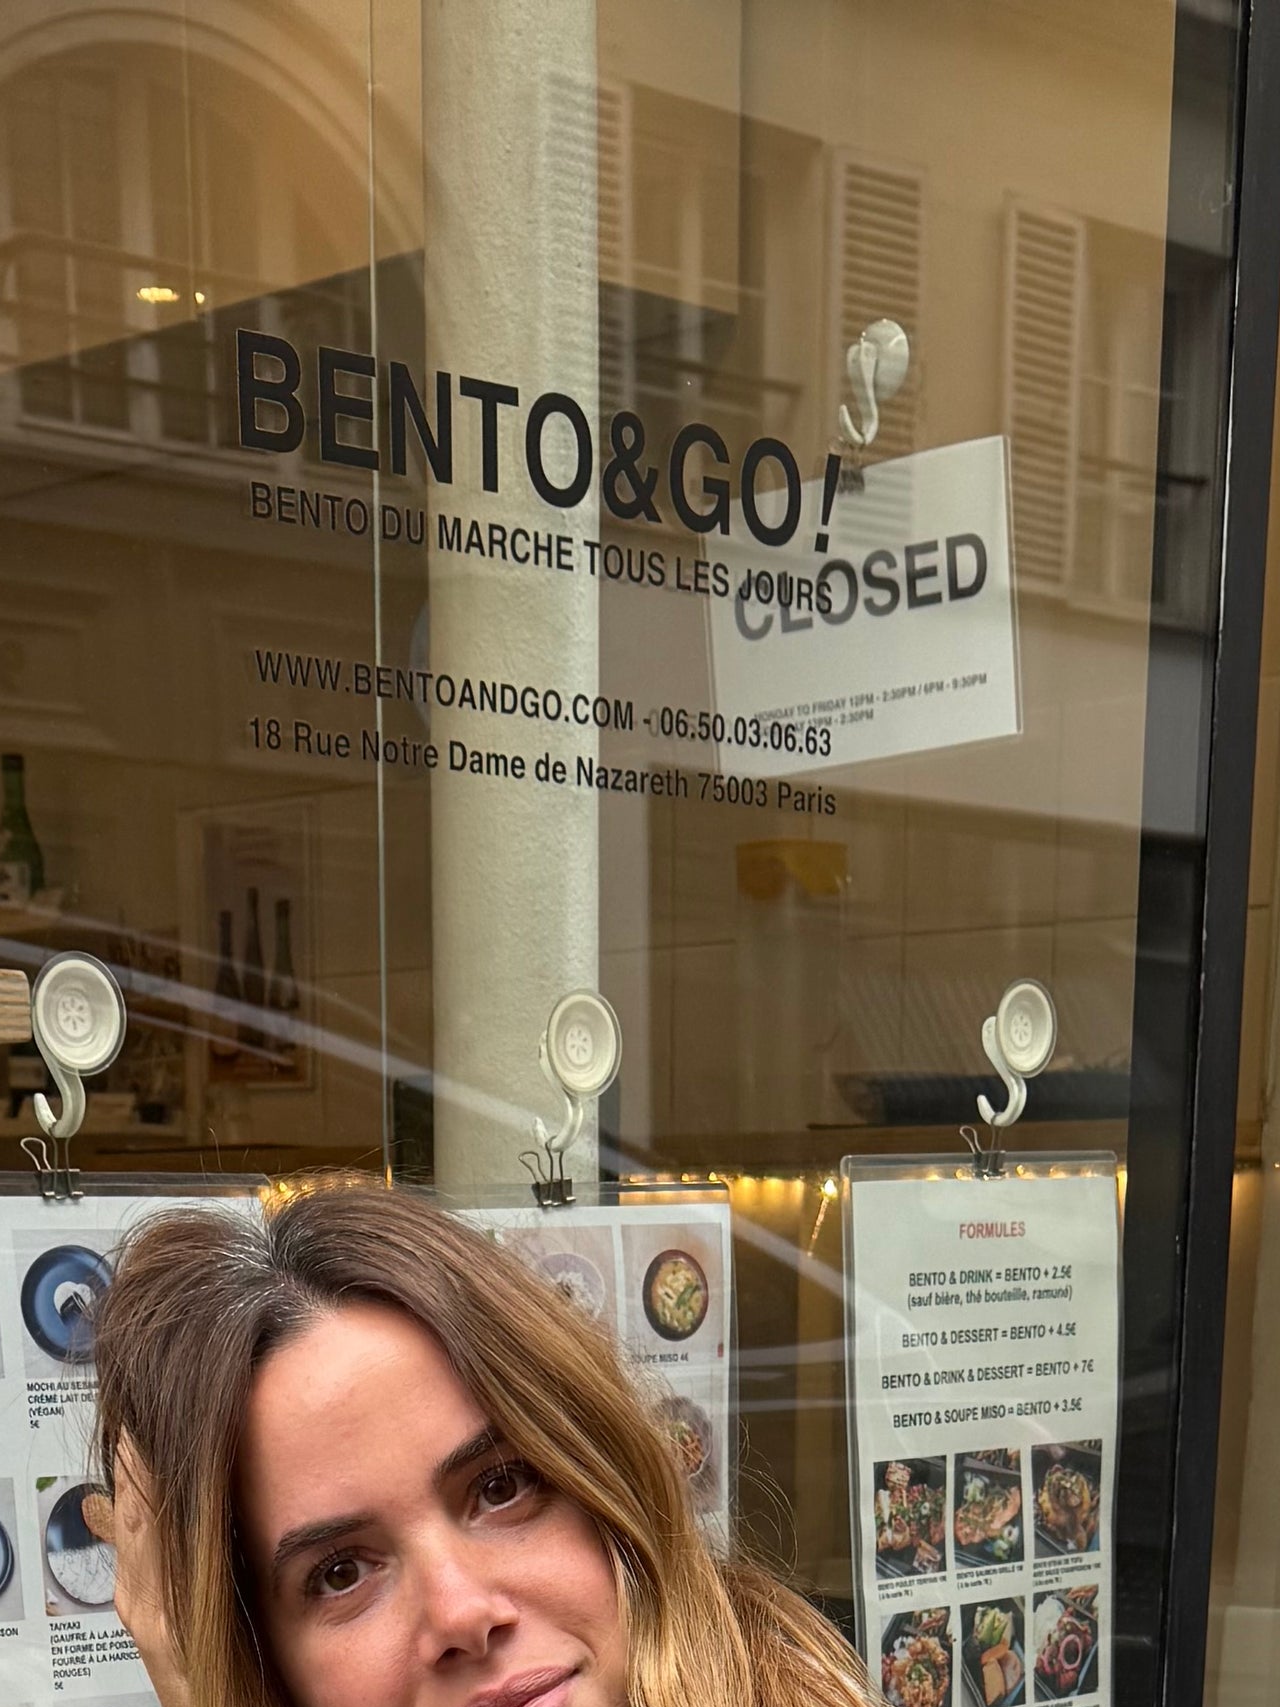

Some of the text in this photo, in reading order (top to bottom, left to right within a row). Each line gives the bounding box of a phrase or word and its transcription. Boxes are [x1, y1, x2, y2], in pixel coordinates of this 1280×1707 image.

[235, 328, 841, 554] BENTO&GO!
[250, 481, 833, 615] BENTO DU MARCHE TOUS LES JOURS
[734, 532, 988, 641] CLOSED
[255, 649, 634, 731] WWW.BENTOANDGO.COM
[660, 706, 832, 757] 06.50.03.06.63
[797, 703, 810, 716] TO
[812, 696, 846, 714] FRIDAY
[249, 716, 836, 816] 18 Rue Notre Dame de Nazareth 75003 Paris
[959, 1221, 1025, 1240] FORMULES
[909, 1271, 946, 1287] BENTO
[959, 1269, 993, 1285] DRINK
[1004, 1266, 1041, 1282] BENTO
[902, 1332, 938, 1348] BENTO
[950, 1328, 999, 1344] DESSERT
[1010, 1324, 1046, 1340] BENTO
[882, 1373, 921, 1389] BENTO
[934, 1369, 965, 1385] DRINK
[977, 1364, 1024, 1382] DESSERT
[1035, 1361, 1070, 1376] BENTO
[893, 1411, 932, 1428] BENTO
[945, 1407, 978, 1424] SOUPE
[981, 1404, 1006, 1420] MISO
[1017, 1400, 1051, 1416] BENTO
